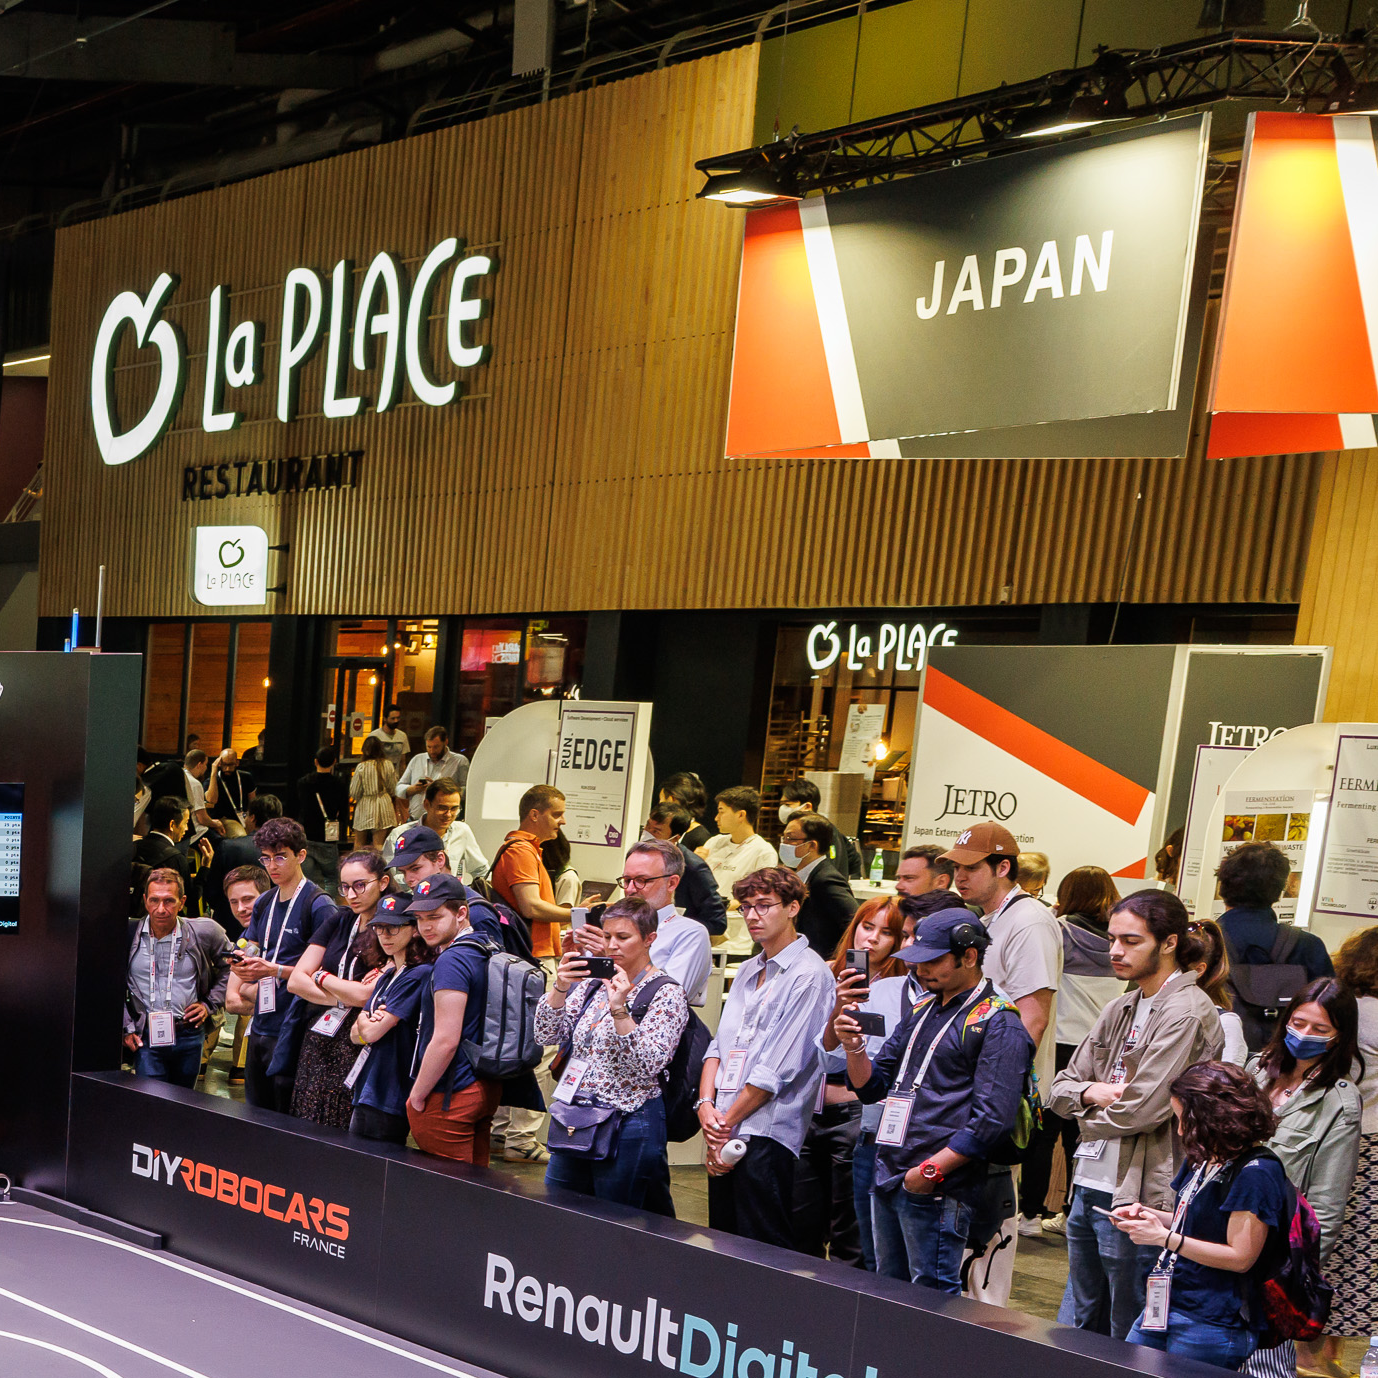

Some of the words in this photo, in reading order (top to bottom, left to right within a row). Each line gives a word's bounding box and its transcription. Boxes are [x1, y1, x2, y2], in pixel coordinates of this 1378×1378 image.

[916, 229, 1114, 321] JAPAN
[202, 283, 256, 433] La
[276, 237, 492, 423] PLACE
[181, 449, 366, 502] RESTAURANT
[220, 571, 255, 590] PLACE
[846, 623, 871, 671] La
[572, 738, 627, 772] EDGE
[934, 784, 1018, 822] JETRO
[1337, 801, 1376, 811] Fermenting
[913, 825, 934, 837] Japan
[131, 1141, 350, 1242] DIYROBOCARS
[292, 1229, 346, 1260] FRANCE
